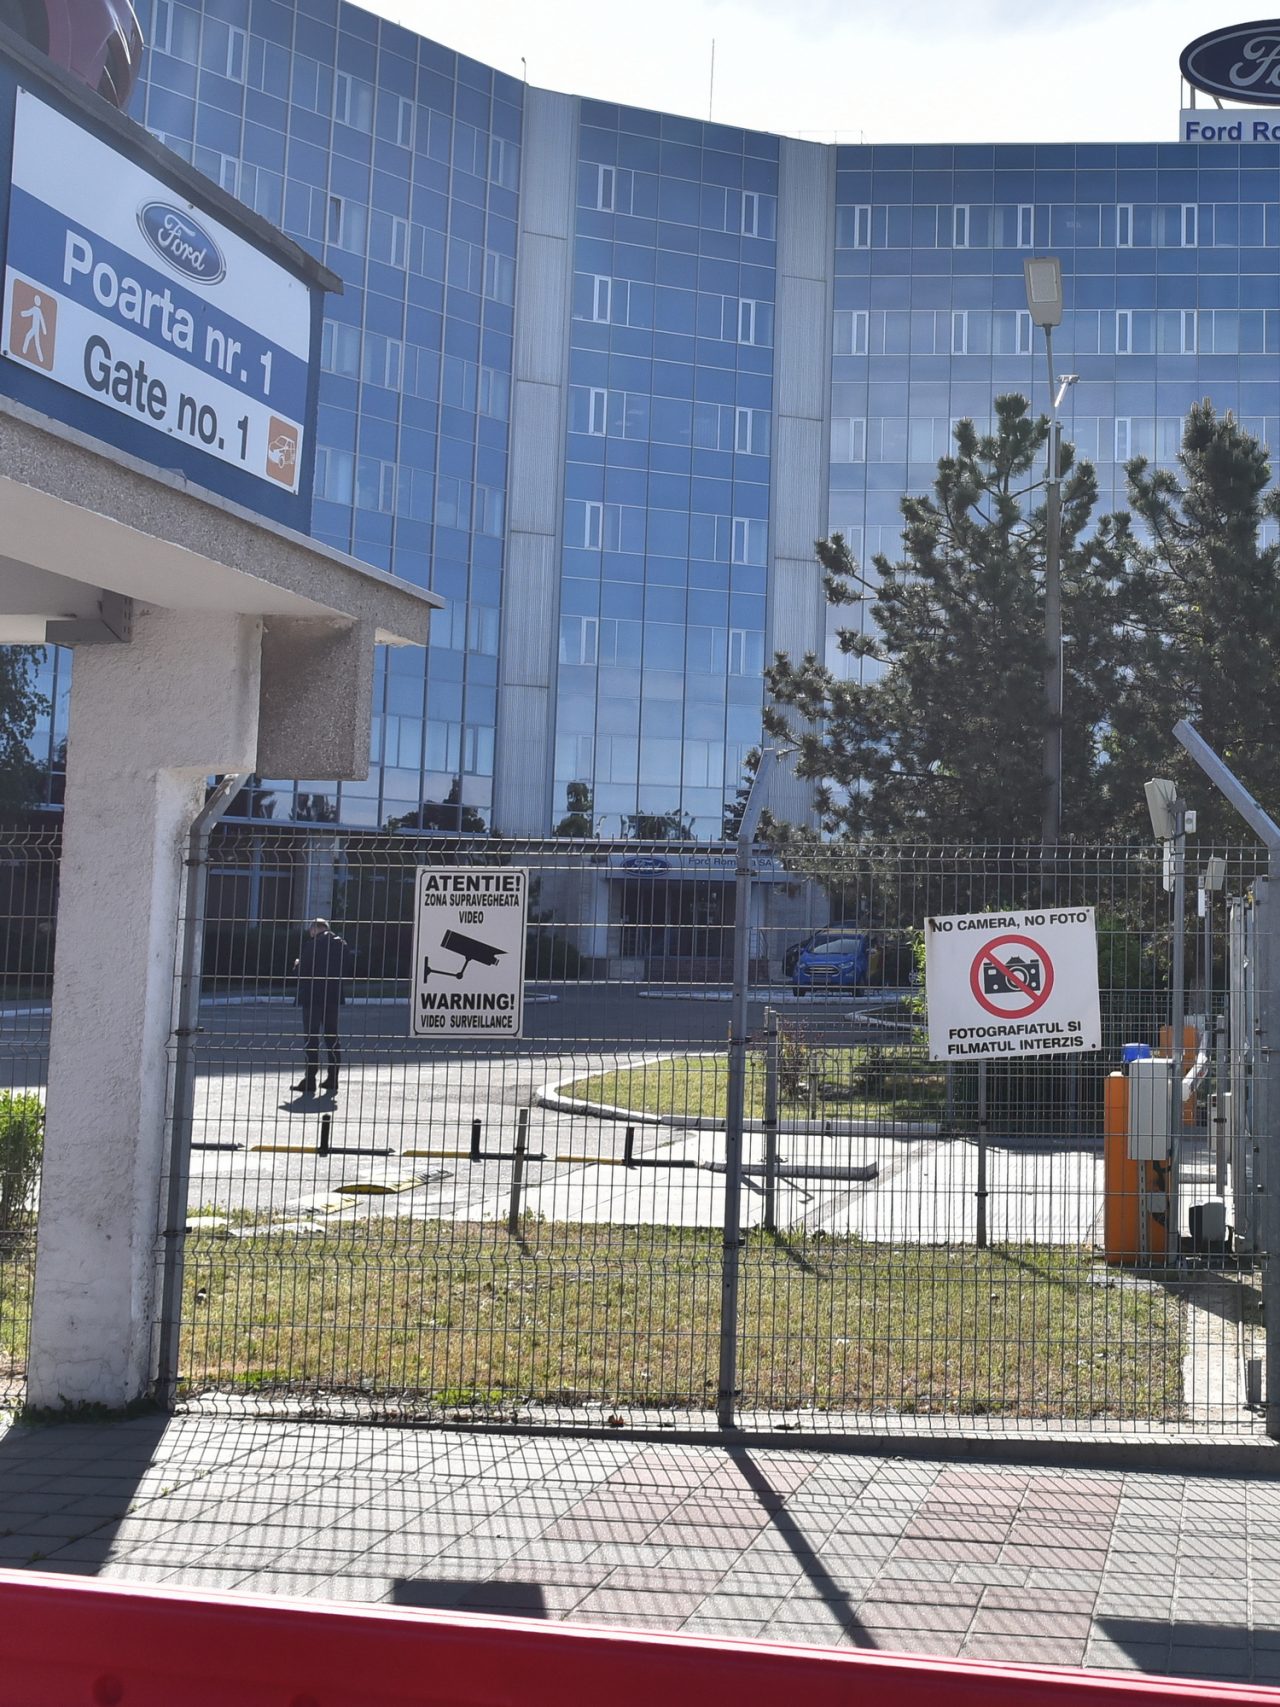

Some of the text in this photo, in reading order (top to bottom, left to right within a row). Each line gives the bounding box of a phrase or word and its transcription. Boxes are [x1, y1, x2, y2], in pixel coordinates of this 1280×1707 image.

[1185, 121, 1242, 141] Ford
[158, 213, 207, 272] Ford
[63, 229, 272, 396] Poarta nr. 1
[83, 334, 249, 461] Gate no. 1
[759, 859, 772, 867] SA
[425, 875, 521, 892] ATENTIE!
[424, 893, 520, 907] ZONA SUPRAVEGHEATA
[459, 910, 484, 924] VIDEO
[932, 911, 1087, 933] NO CAMERA, NO FOTO
[421, 993, 515, 1011] WARNING!
[421, 1014, 513, 1029] VIDEO SURVEILLANCE
[948, 1020, 1082, 1040] FOTOGRAFIATUL SI
[947, 1035, 1084, 1055] FILMATUL INTERZIS
